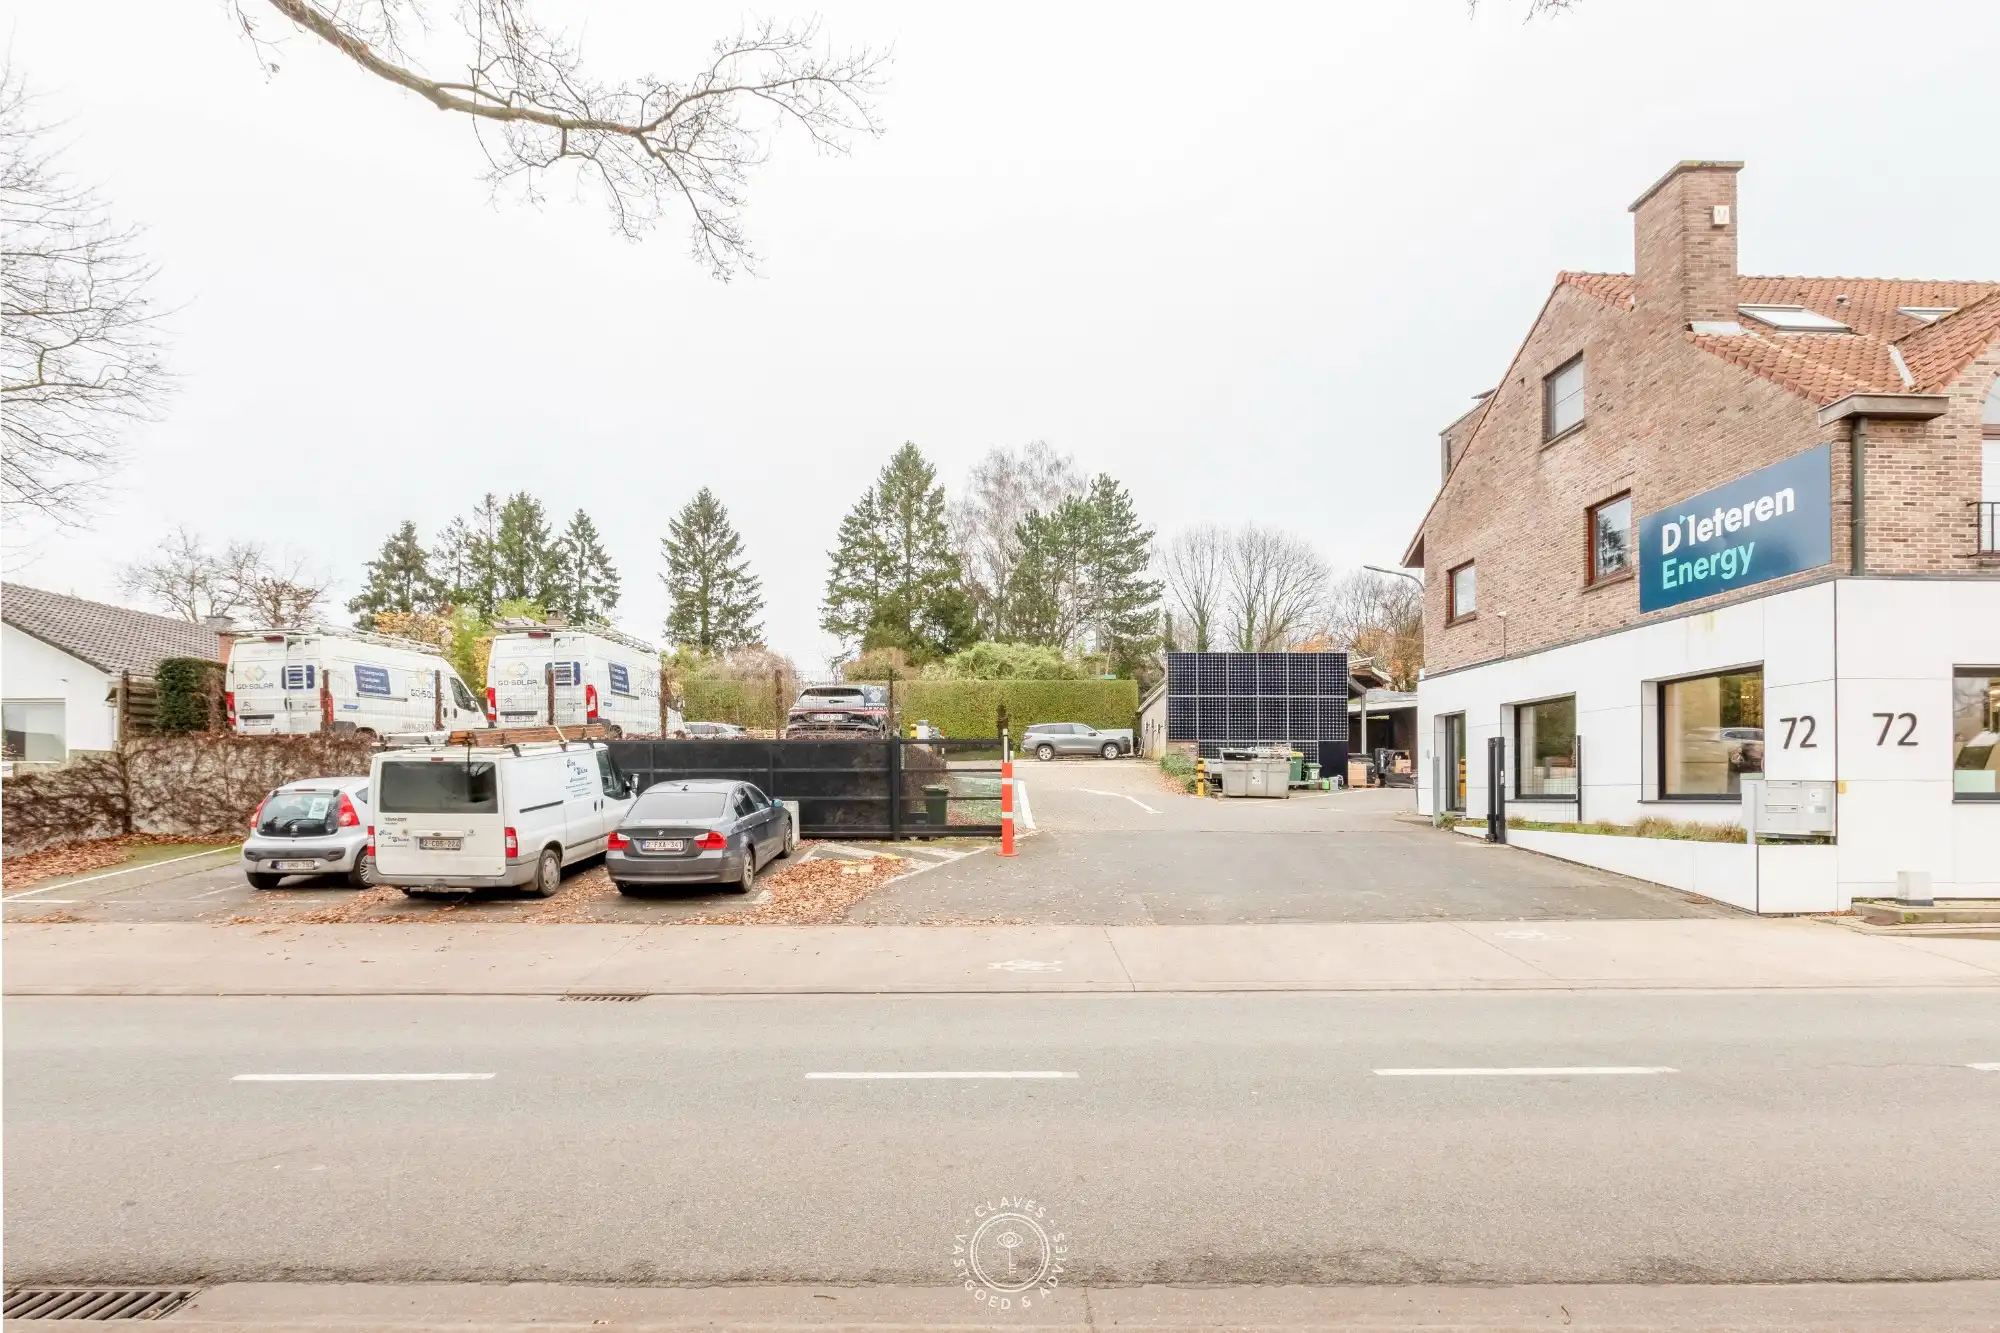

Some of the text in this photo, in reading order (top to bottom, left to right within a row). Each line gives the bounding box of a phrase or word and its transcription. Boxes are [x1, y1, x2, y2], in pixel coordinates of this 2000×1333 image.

[1662, 541, 1756, 590] Energy
[1779, 715, 1817, 750] 72
[1872, 712, 1919, 746] 72
